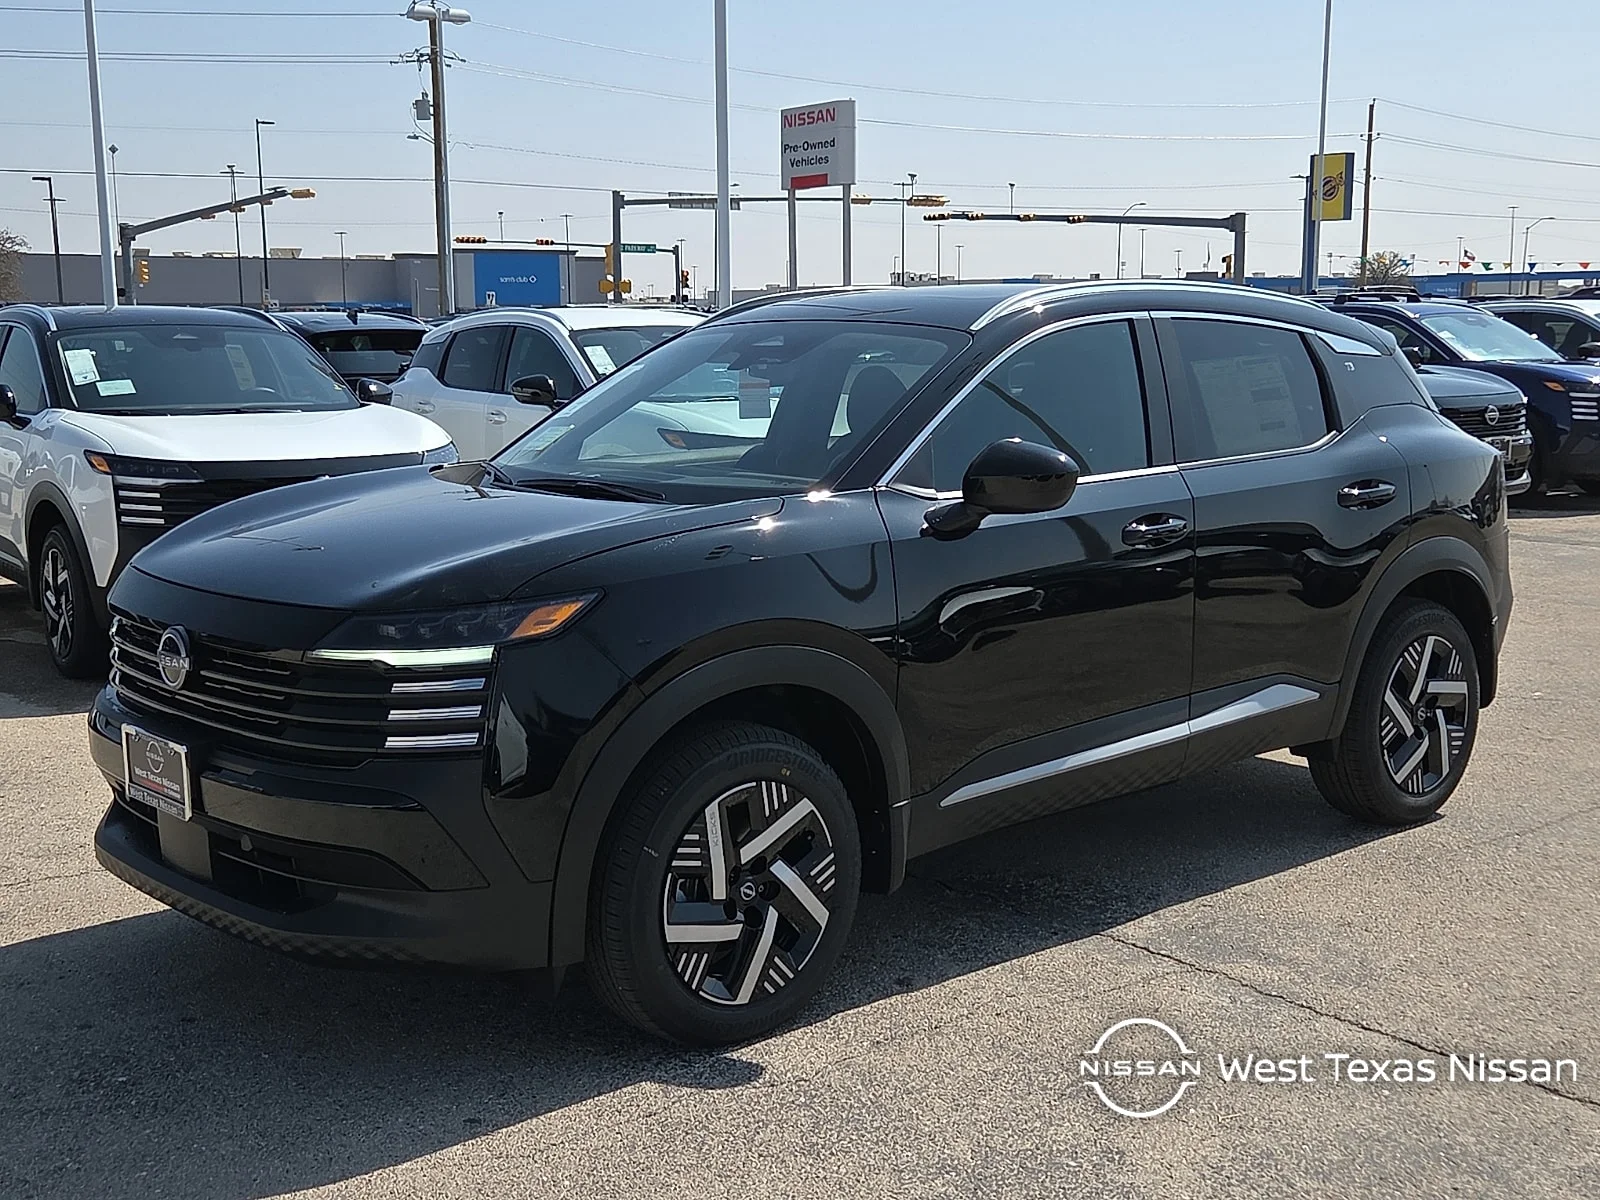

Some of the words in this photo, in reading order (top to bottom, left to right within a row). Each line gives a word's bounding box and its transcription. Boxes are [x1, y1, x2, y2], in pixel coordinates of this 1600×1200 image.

[783, 107, 836, 129] NISSAN
[783, 137, 836, 154] Pre-Owned
[789, 155, 830, 168] Vehicles
[159, 653, 188, 669] SSAN
[726, 748, 823, 781] BRIDGESTONE
[709, 811, 719, 848] KICKS
